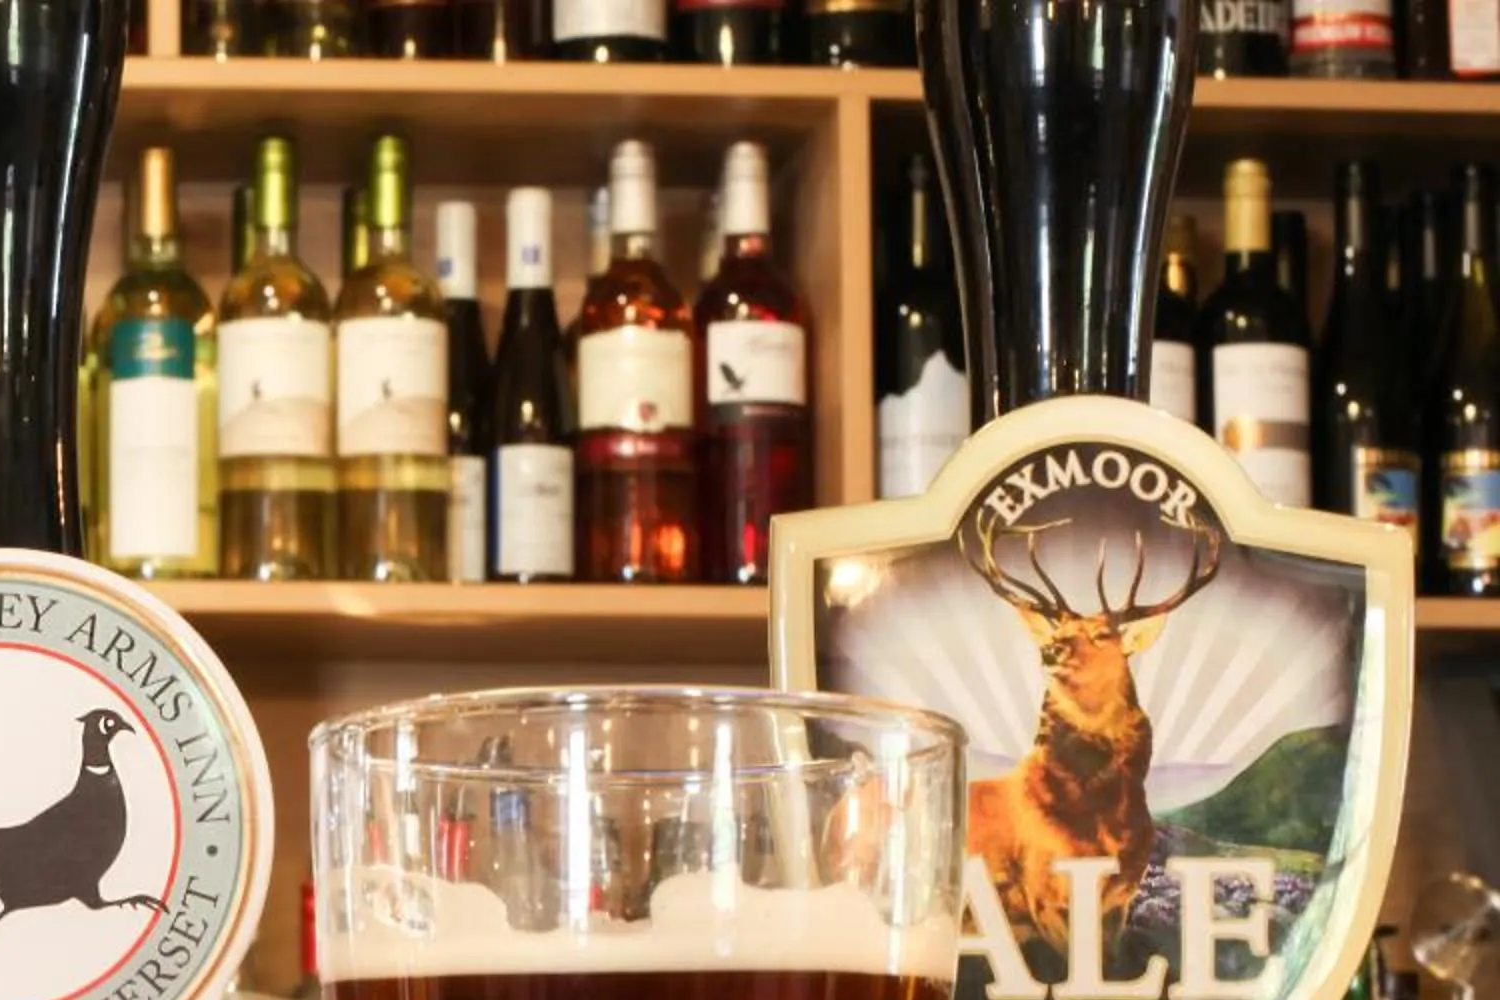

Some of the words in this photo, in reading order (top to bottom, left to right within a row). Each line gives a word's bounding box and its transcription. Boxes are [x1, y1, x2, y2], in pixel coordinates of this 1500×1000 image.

[984, 450, 1198, 528] EXMOOR
[65, 614, 193, 724] ARMS
[175, 731, 231, 826] INN
